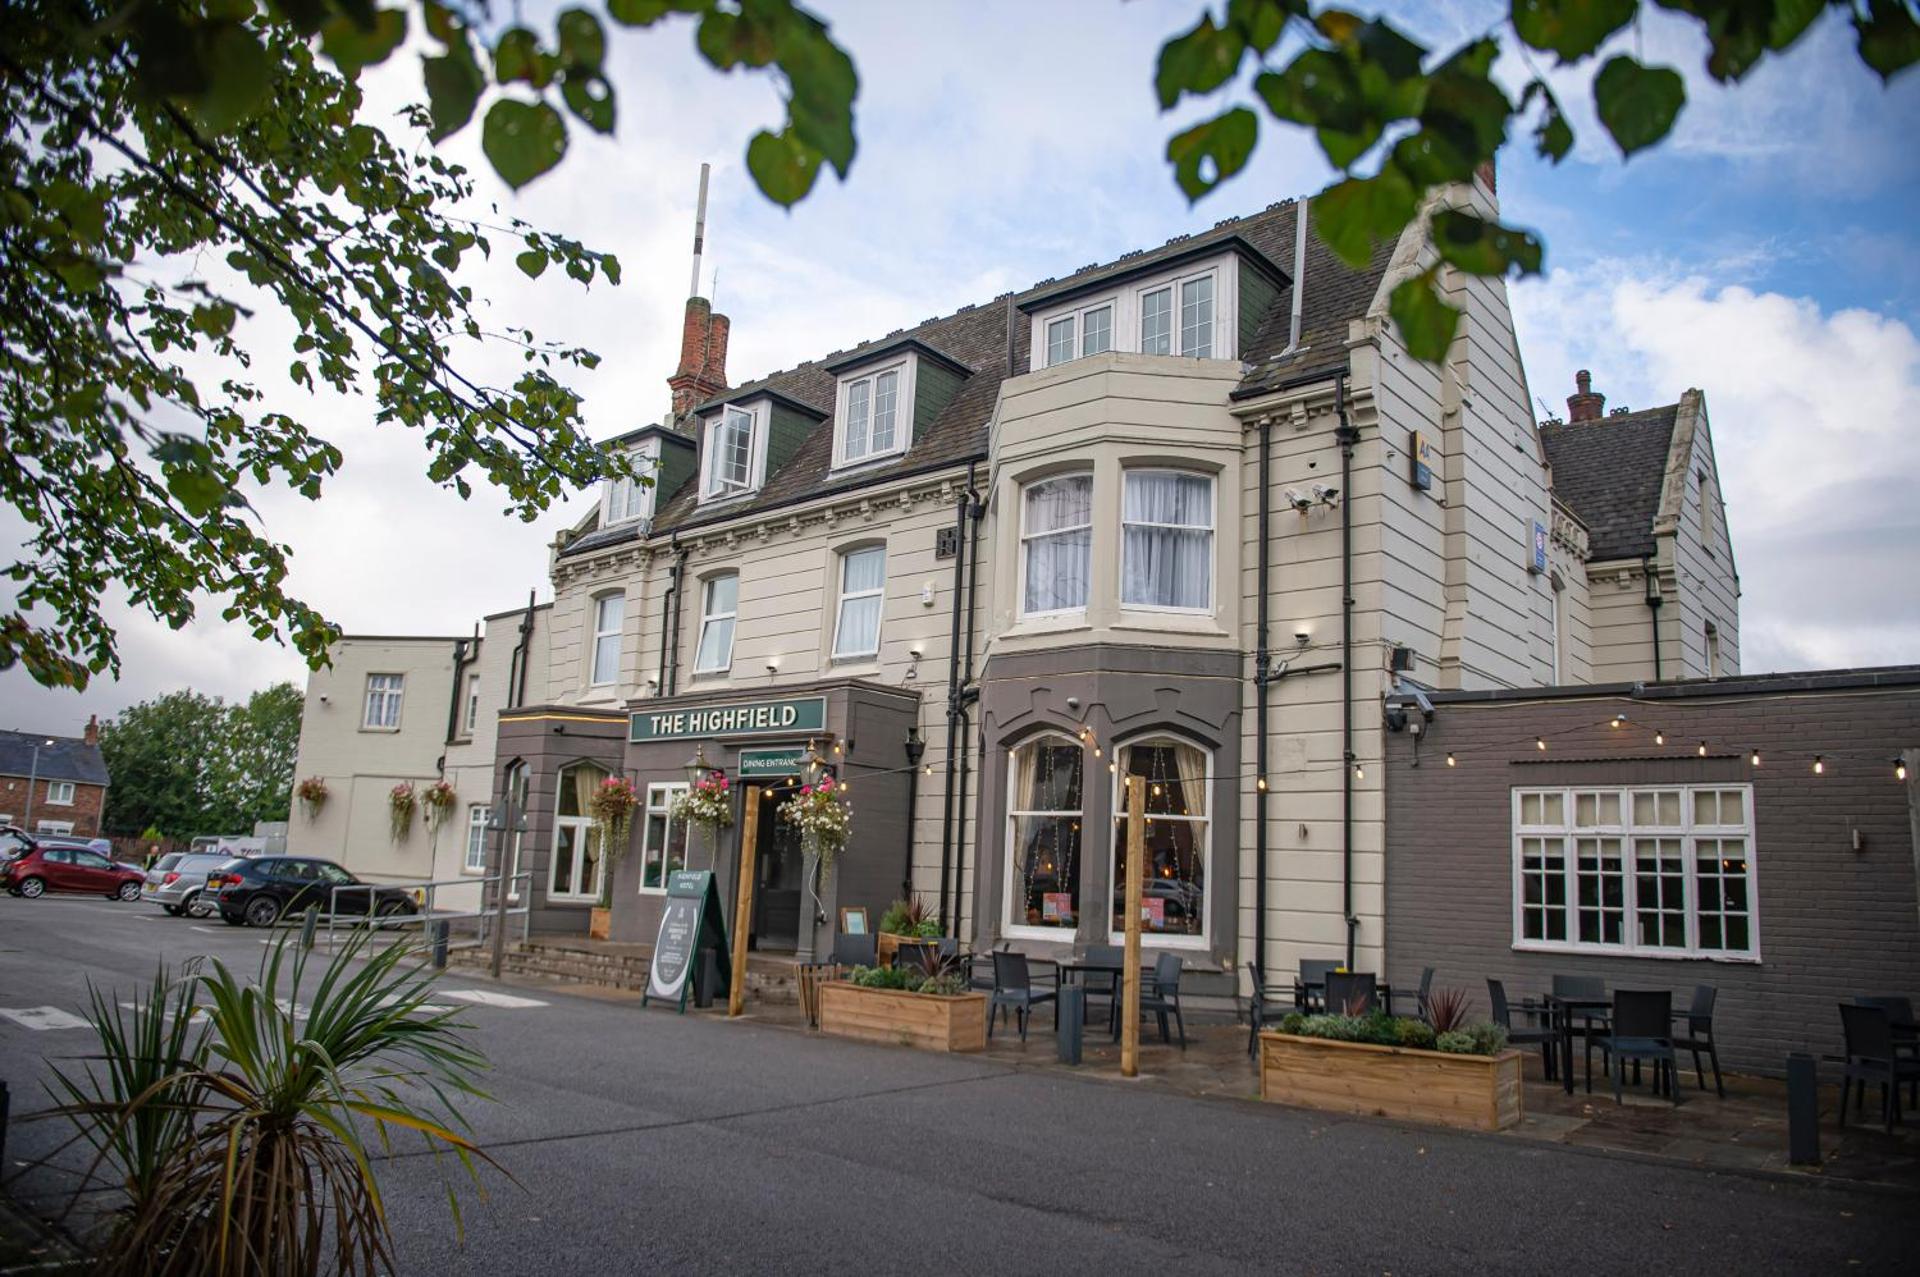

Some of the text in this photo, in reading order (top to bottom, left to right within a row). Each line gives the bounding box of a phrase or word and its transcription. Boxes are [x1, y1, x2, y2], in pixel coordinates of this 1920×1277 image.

[650, 705, 798, 735] THE HIGHFIELD
[743, 758, 798, 768] DINING ENTRANC
